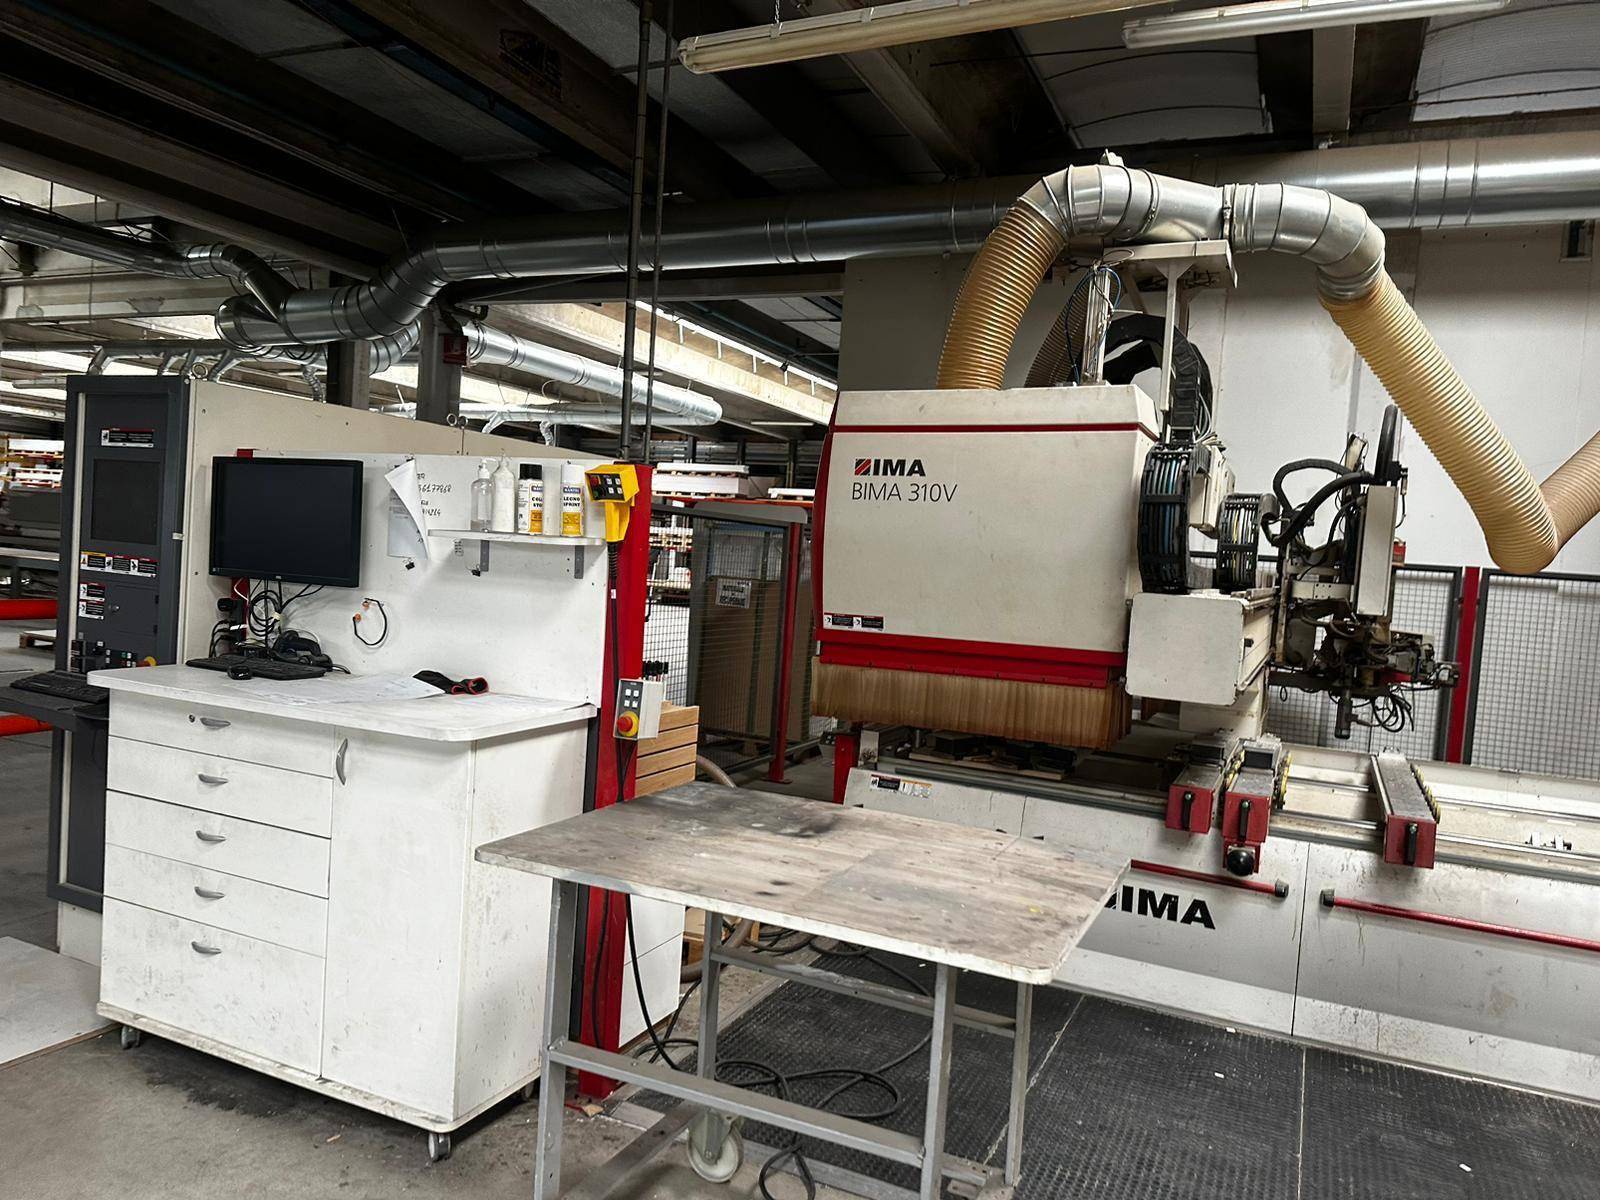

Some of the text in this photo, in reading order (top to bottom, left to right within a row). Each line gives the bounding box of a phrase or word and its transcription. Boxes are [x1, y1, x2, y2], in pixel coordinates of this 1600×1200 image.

[872, 458, 926, 477] IMA
[851, 482, 958, 503] BIMA 310V
[1121, 884, 1216, 930] IMA
